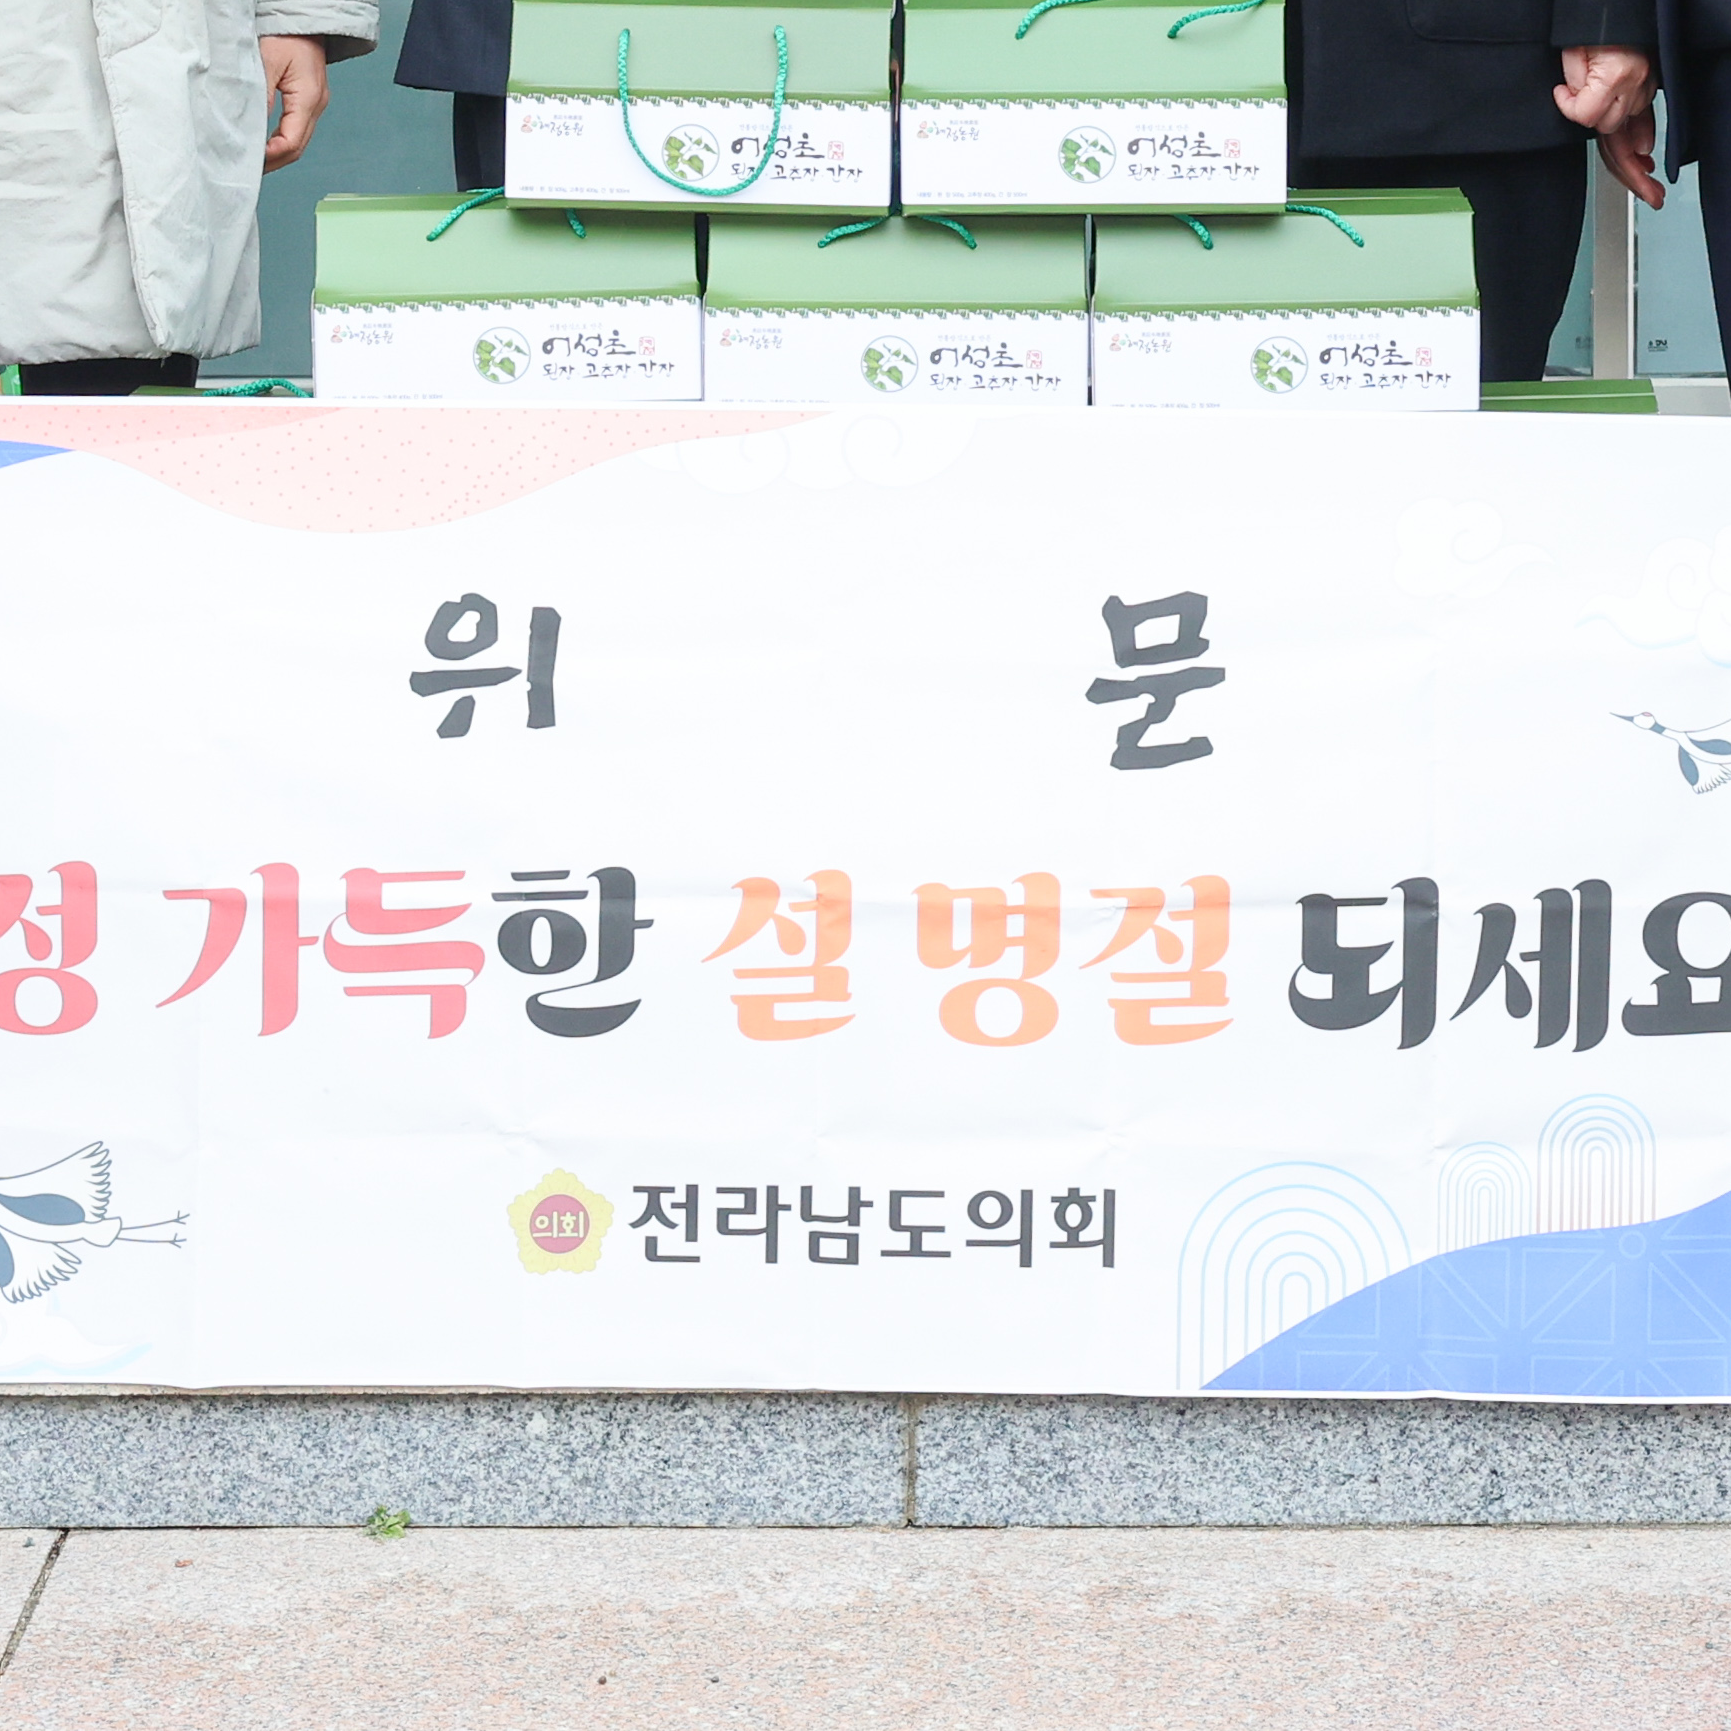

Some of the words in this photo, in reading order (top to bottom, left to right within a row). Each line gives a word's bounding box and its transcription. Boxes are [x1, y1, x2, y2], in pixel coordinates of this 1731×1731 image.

[731, 132, 826, 159] 어성초
[1127, 131, 1222, 159] 어성초
[1127, 163, 1161, 182] 된장
[1166, 163, 1217, 182] 고추장
[1222, 162, 1261, 182] 간장
[542, 329, 637, 357] 어성초
[930, 342, 1024, 369] 어성초
[1319, 340, 1414, 367] 어성초
[410, 592, 562, 739] 위
[1085, 590, 1226, 771] 문
[156, 862, 655, 1039] 가득한
[705, 870, 853, 1042] 설
[916, 872, 1231, 1047] 명절
[532, 1211, 590, 1239] 의회
[628, 1182, 1117, 1269] 전라남도의회
